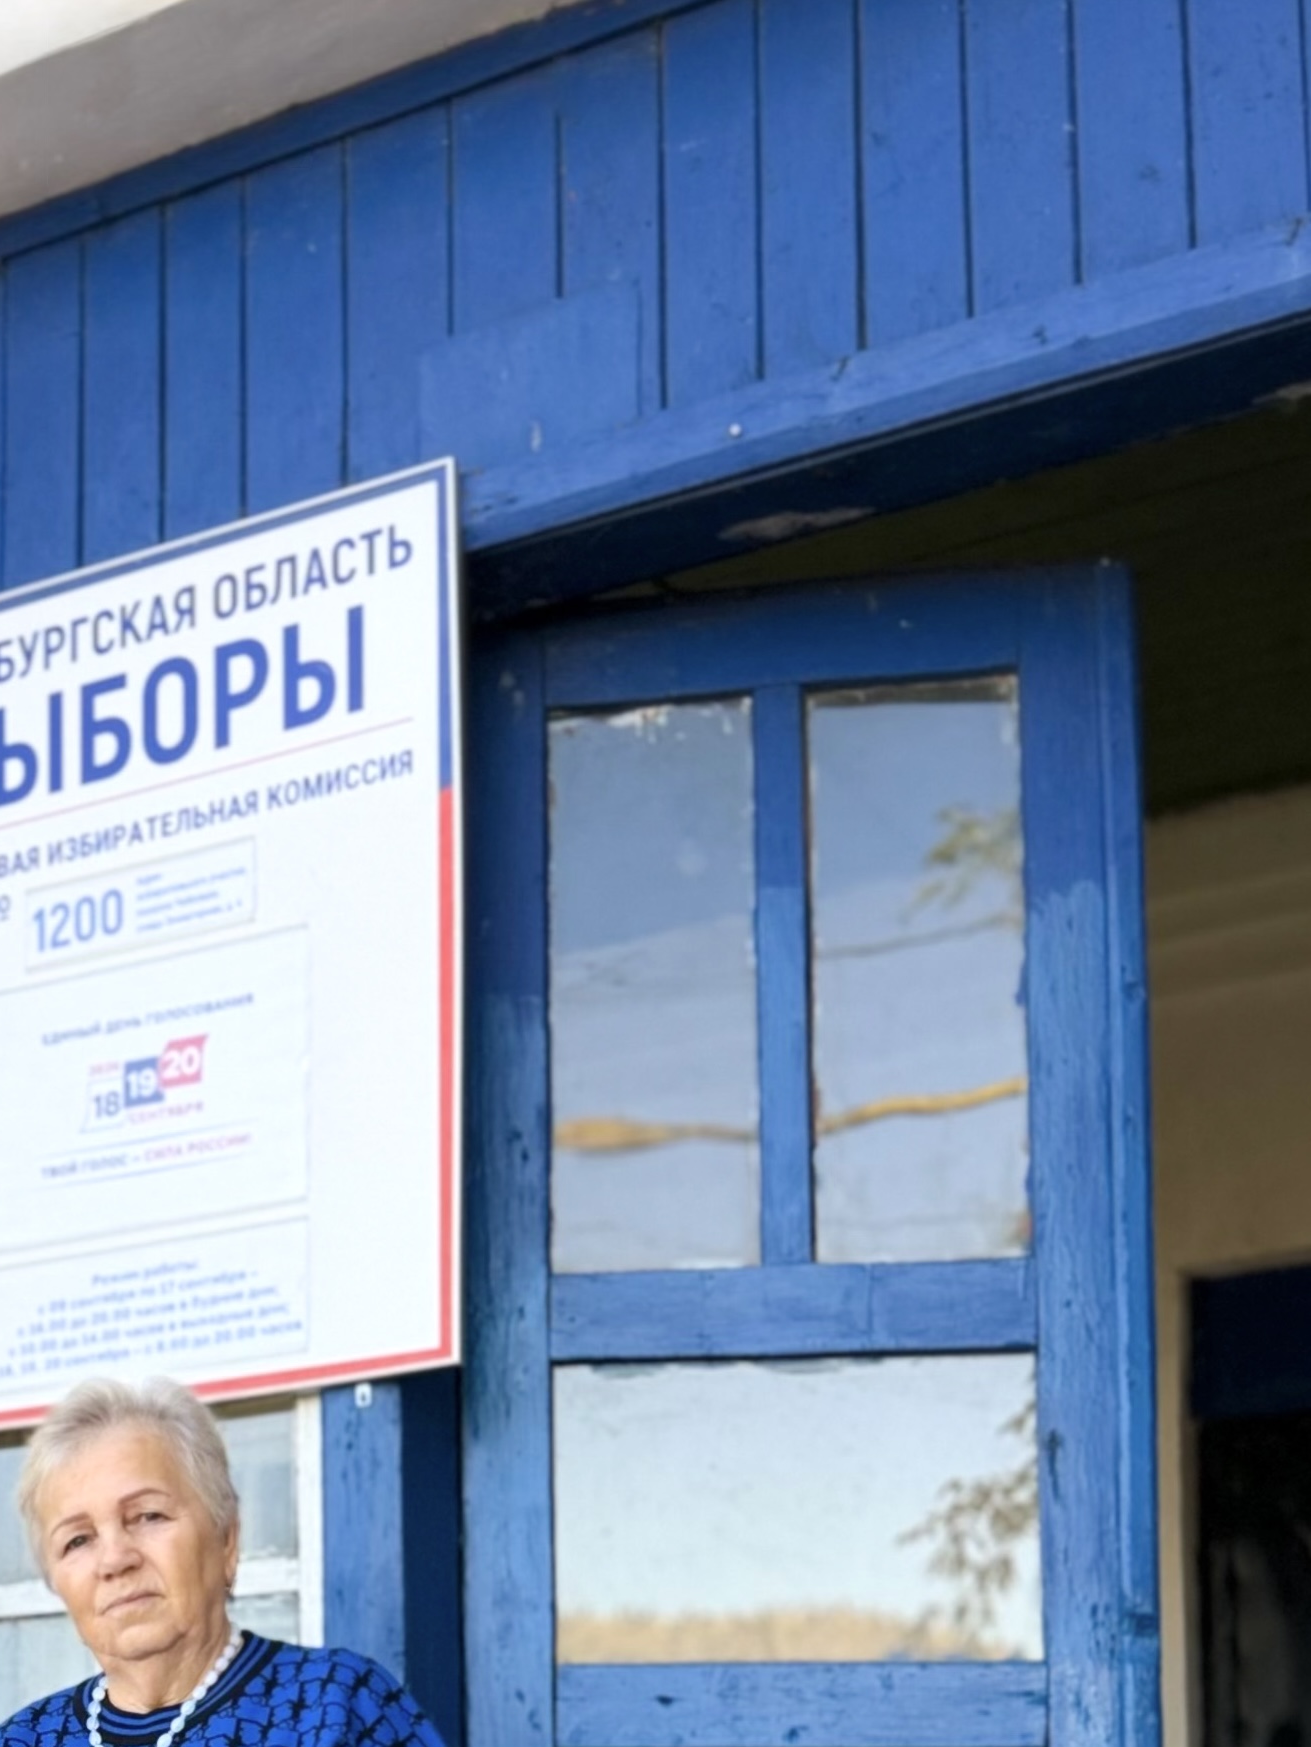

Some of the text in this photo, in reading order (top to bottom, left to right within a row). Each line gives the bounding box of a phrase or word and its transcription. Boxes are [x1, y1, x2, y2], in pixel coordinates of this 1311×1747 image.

[213, 524, 413, 621] ОБЛАСТЬ
[47, 791, 260, 867] ИЗБИРАТЕЛЬНАЯ
[267, 750, 414, 809] КОМИССИЯ
[32, 889, 123, 952] 1200
[145, 992, 254, 1028] ГОЛОСОВАНИЯ
[92, 1091, 122, 1120] 18
[127, 1067, 158, 1101] 19
[160, 1046, 202, 1078] 20
